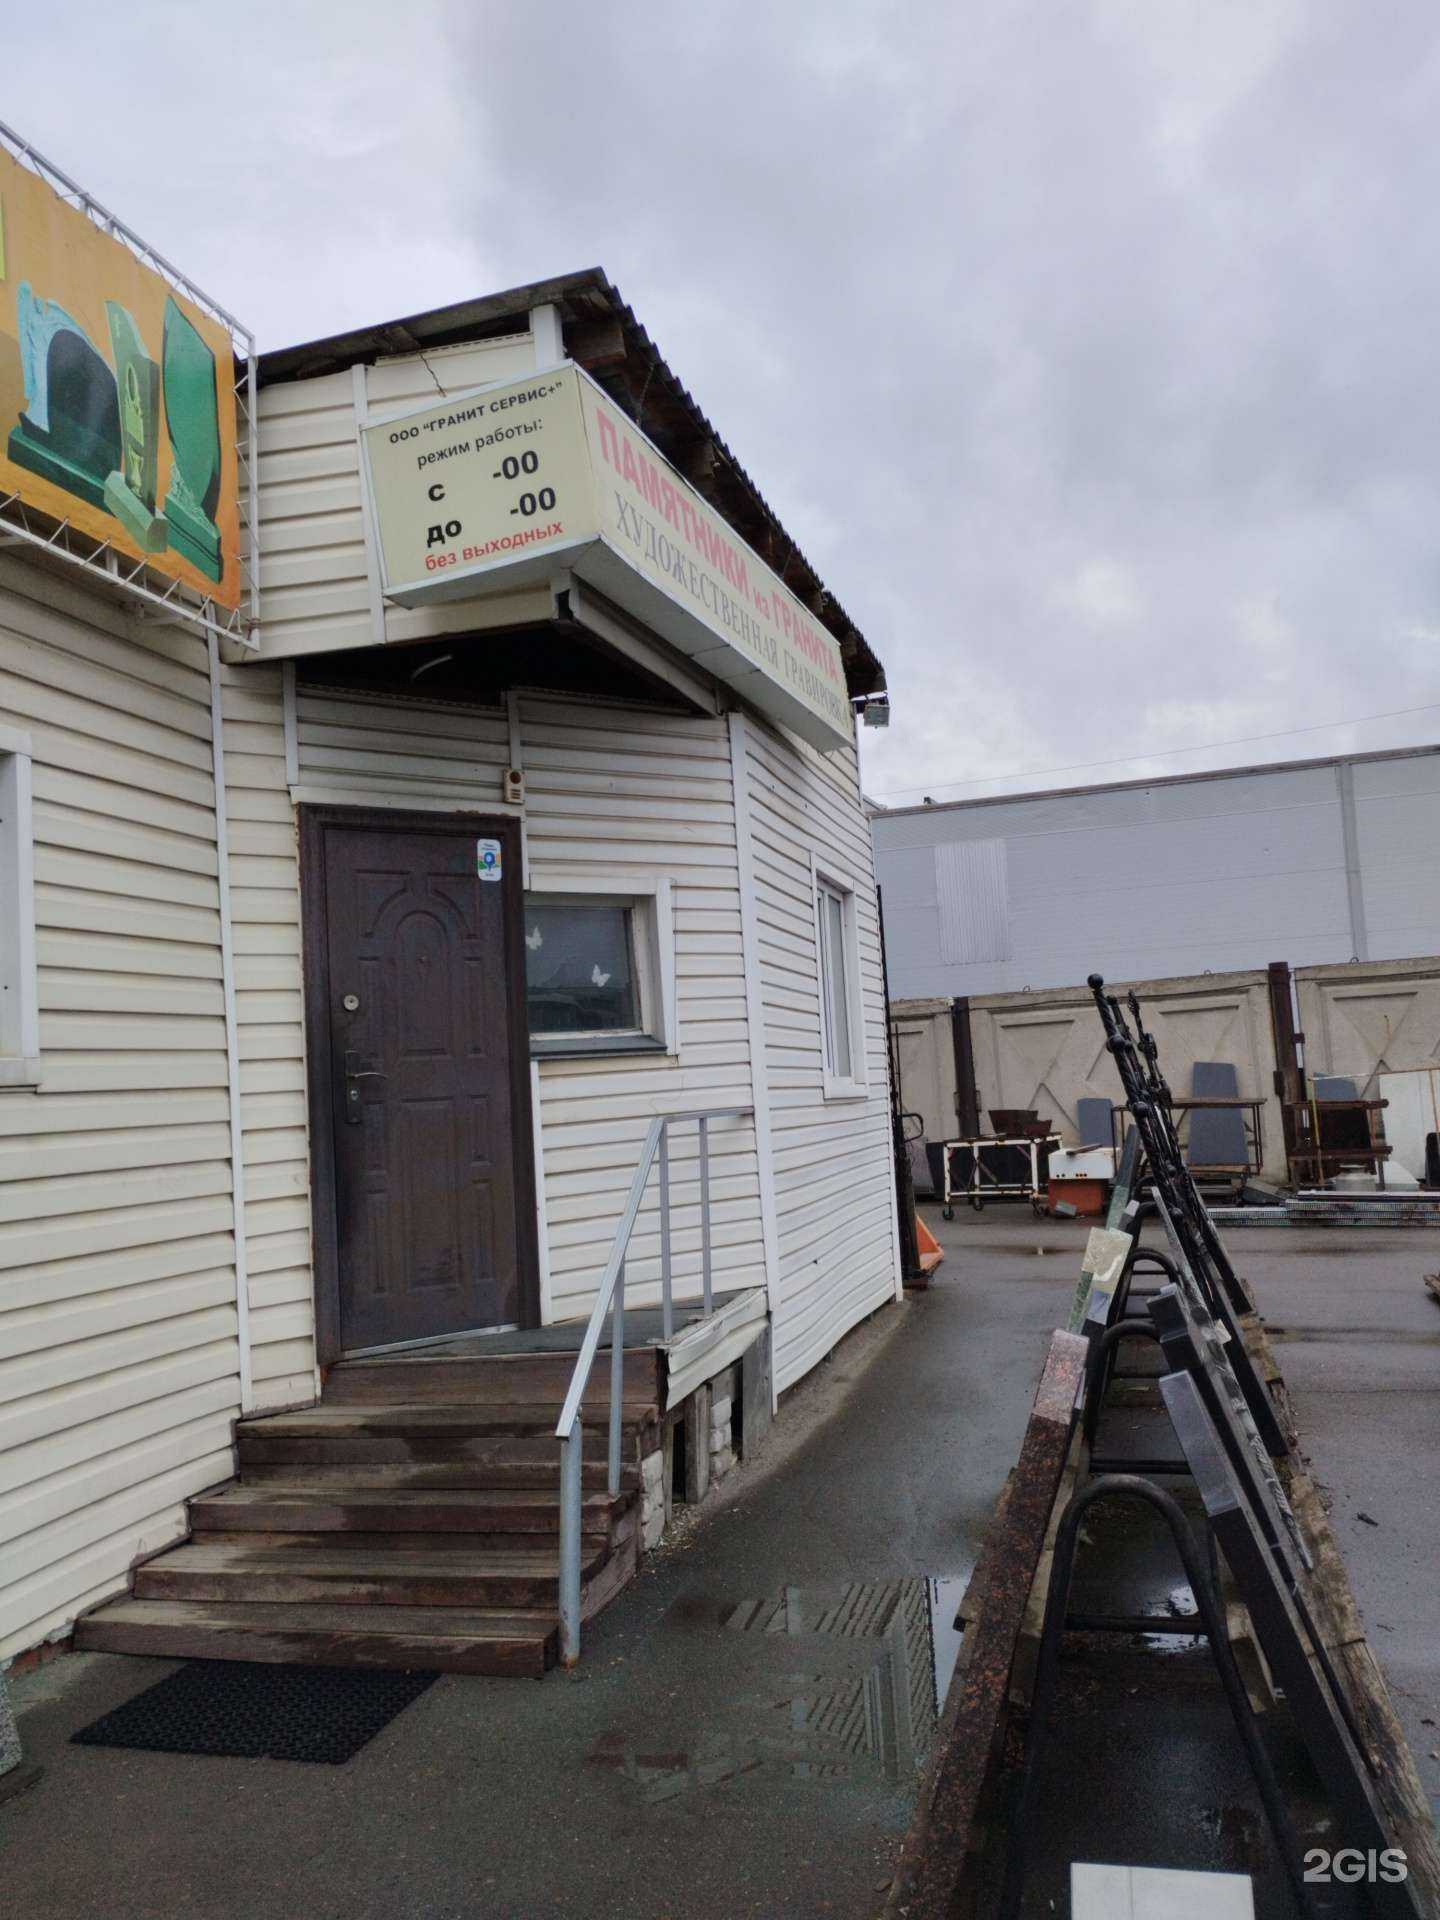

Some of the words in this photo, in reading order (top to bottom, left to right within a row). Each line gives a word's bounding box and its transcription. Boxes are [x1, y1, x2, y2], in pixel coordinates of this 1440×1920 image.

[389, 426, 420, 444] ООО
[417, 442, 470, 470] режим
[475, 417, 543, 452] работы:
[492, 450, 540, 480] -00
[426, 520, 463, 548] до
[509, 487, 557, 517] -00
[425, 552, 457, 571] без
[462, 521, 564, 562] выходных
[596, 407, 750, 599] ПАМЯТНИКИ
[753, 586, 770, 621] из
[772, 591, 839, 685] ГРАНИТА
[614, 490, 779, 670] ХУДОЖЕСТВЕННАЯ
